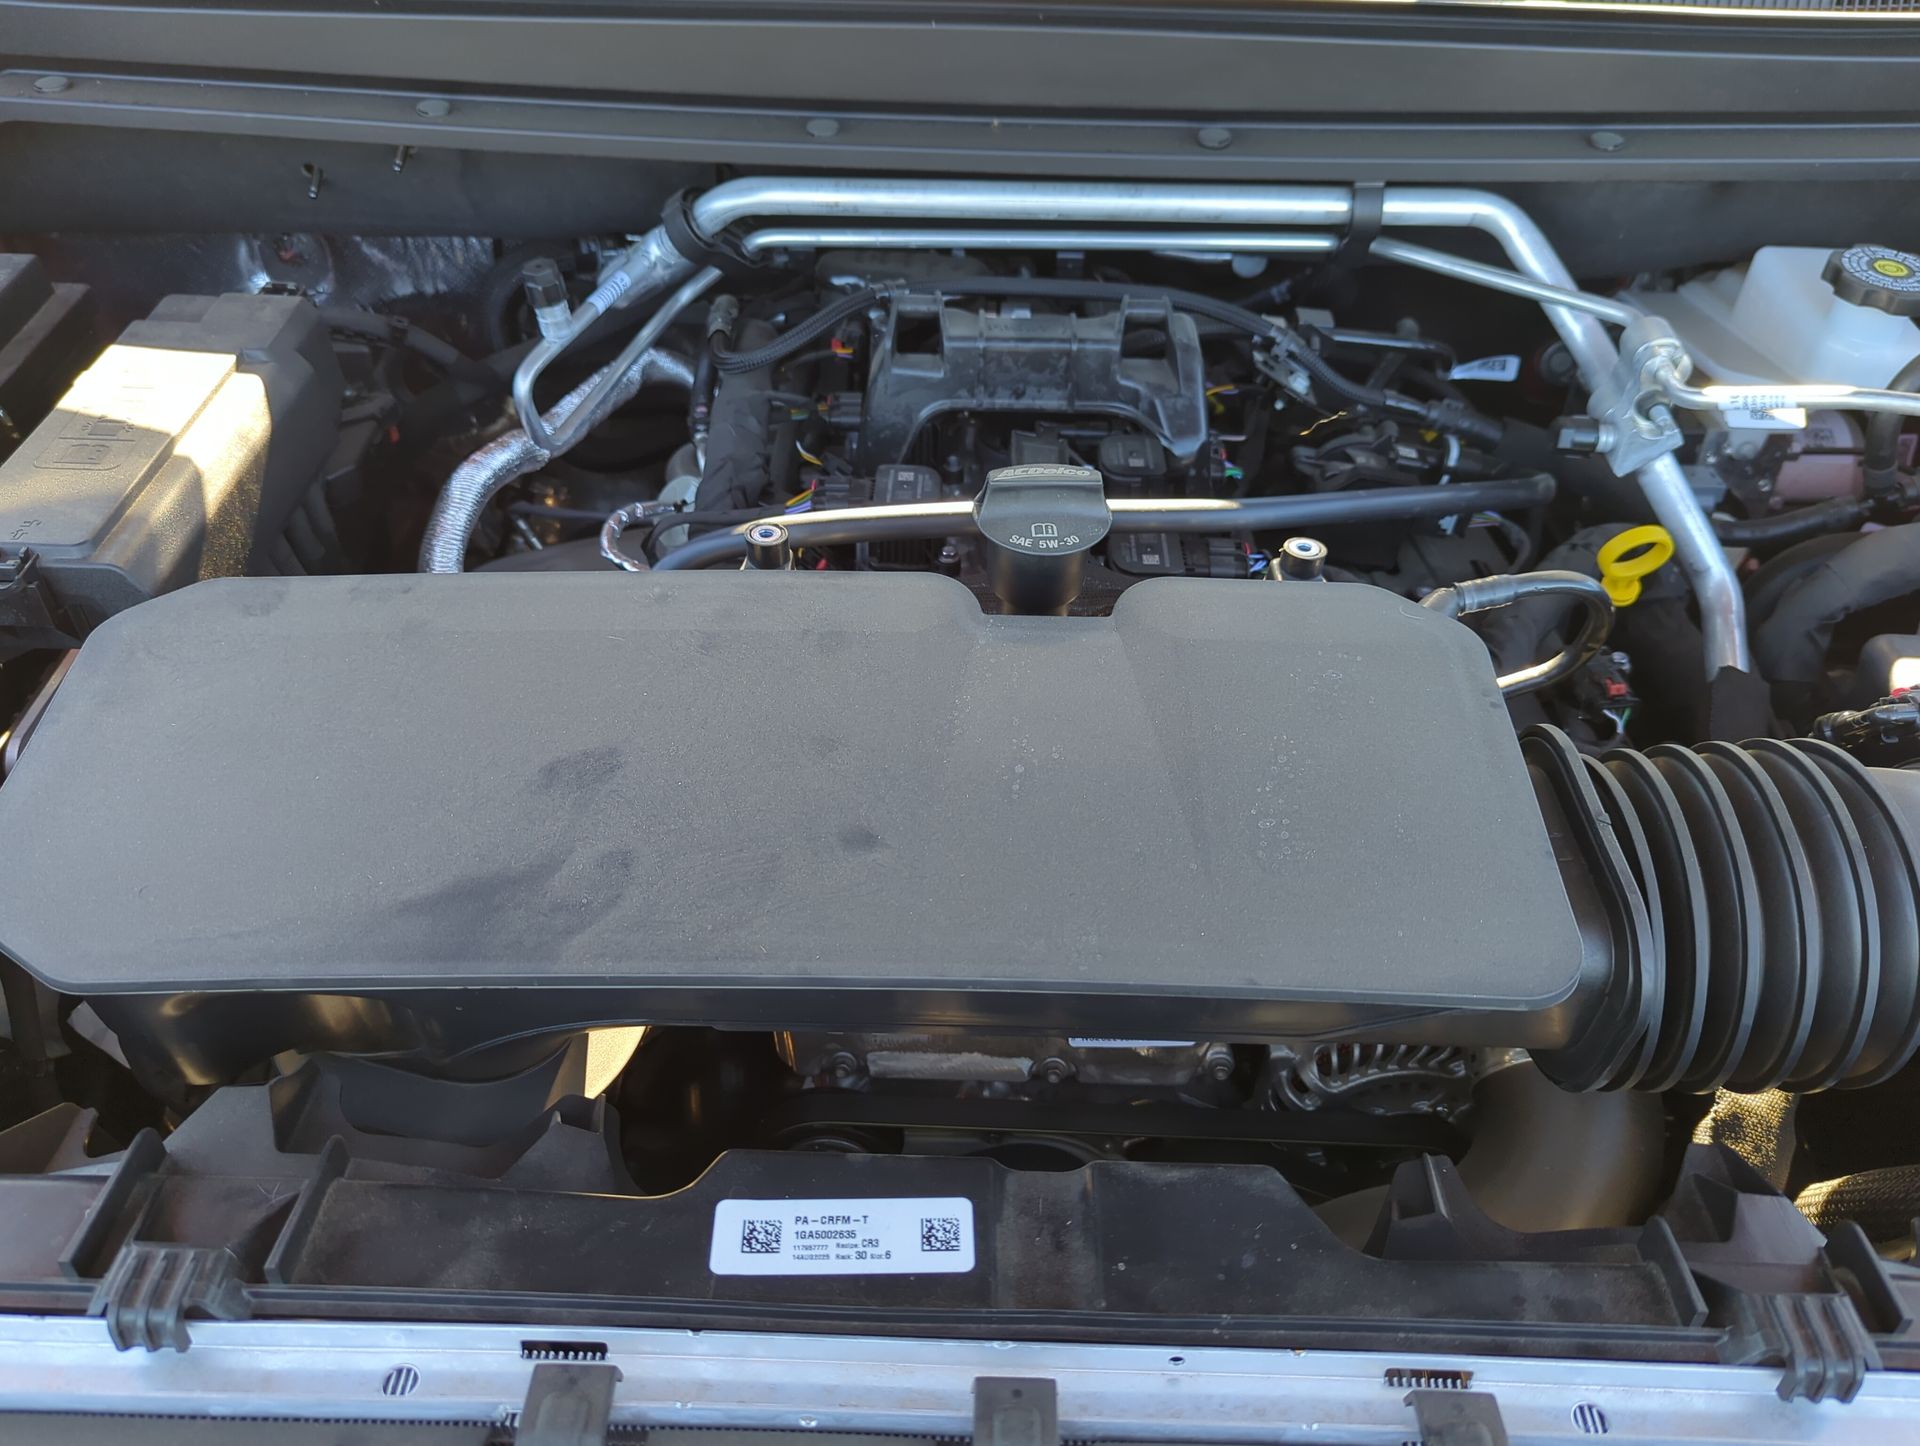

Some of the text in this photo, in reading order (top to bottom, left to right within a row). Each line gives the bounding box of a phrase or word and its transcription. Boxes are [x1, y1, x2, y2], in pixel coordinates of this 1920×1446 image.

[997, 467, 1091, 477] ACDelco
[1009, 534, 1080, 548] SAE 5W-30
[794, 1230, 857, 1240] 1GA5002635
[861, 1238, 879, 1248] CR3
[855, 1250, 868, 1260] 30
[884, 1250, 892, 1260] 6
